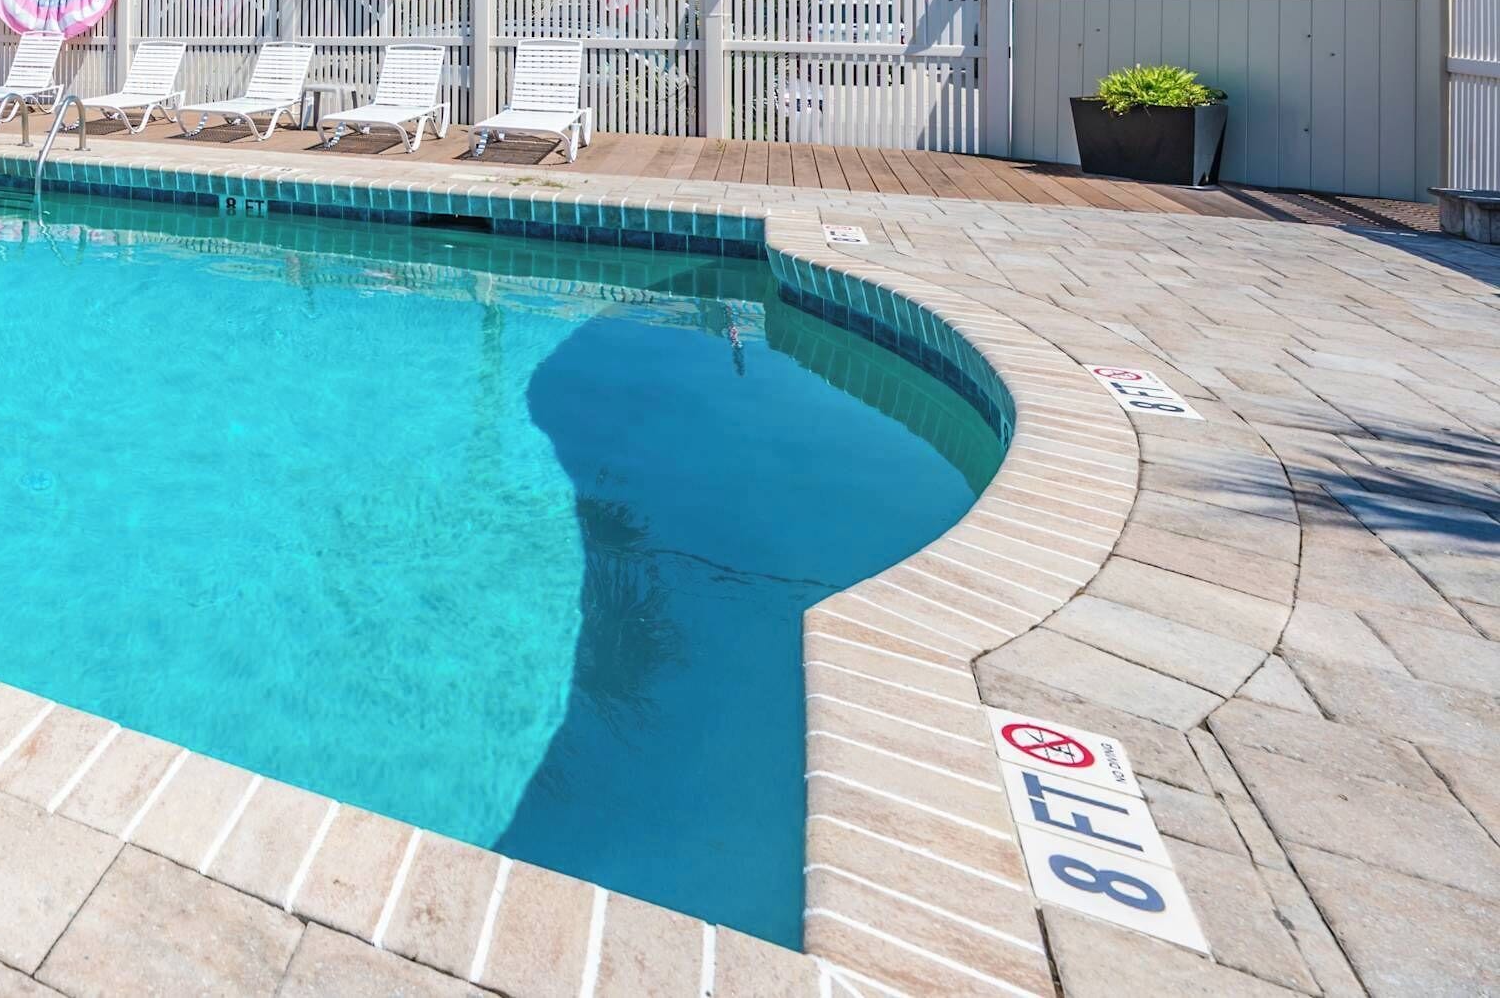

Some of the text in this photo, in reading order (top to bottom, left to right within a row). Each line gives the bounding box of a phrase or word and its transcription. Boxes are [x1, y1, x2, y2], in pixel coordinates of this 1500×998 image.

[245, 198, 265, 211] FT
[1109, 382, 1185, 413] 8 FT
[1100, 742, 1127, 785] NO DIVING
[1022, 771, 1166, 913] 8 FT
